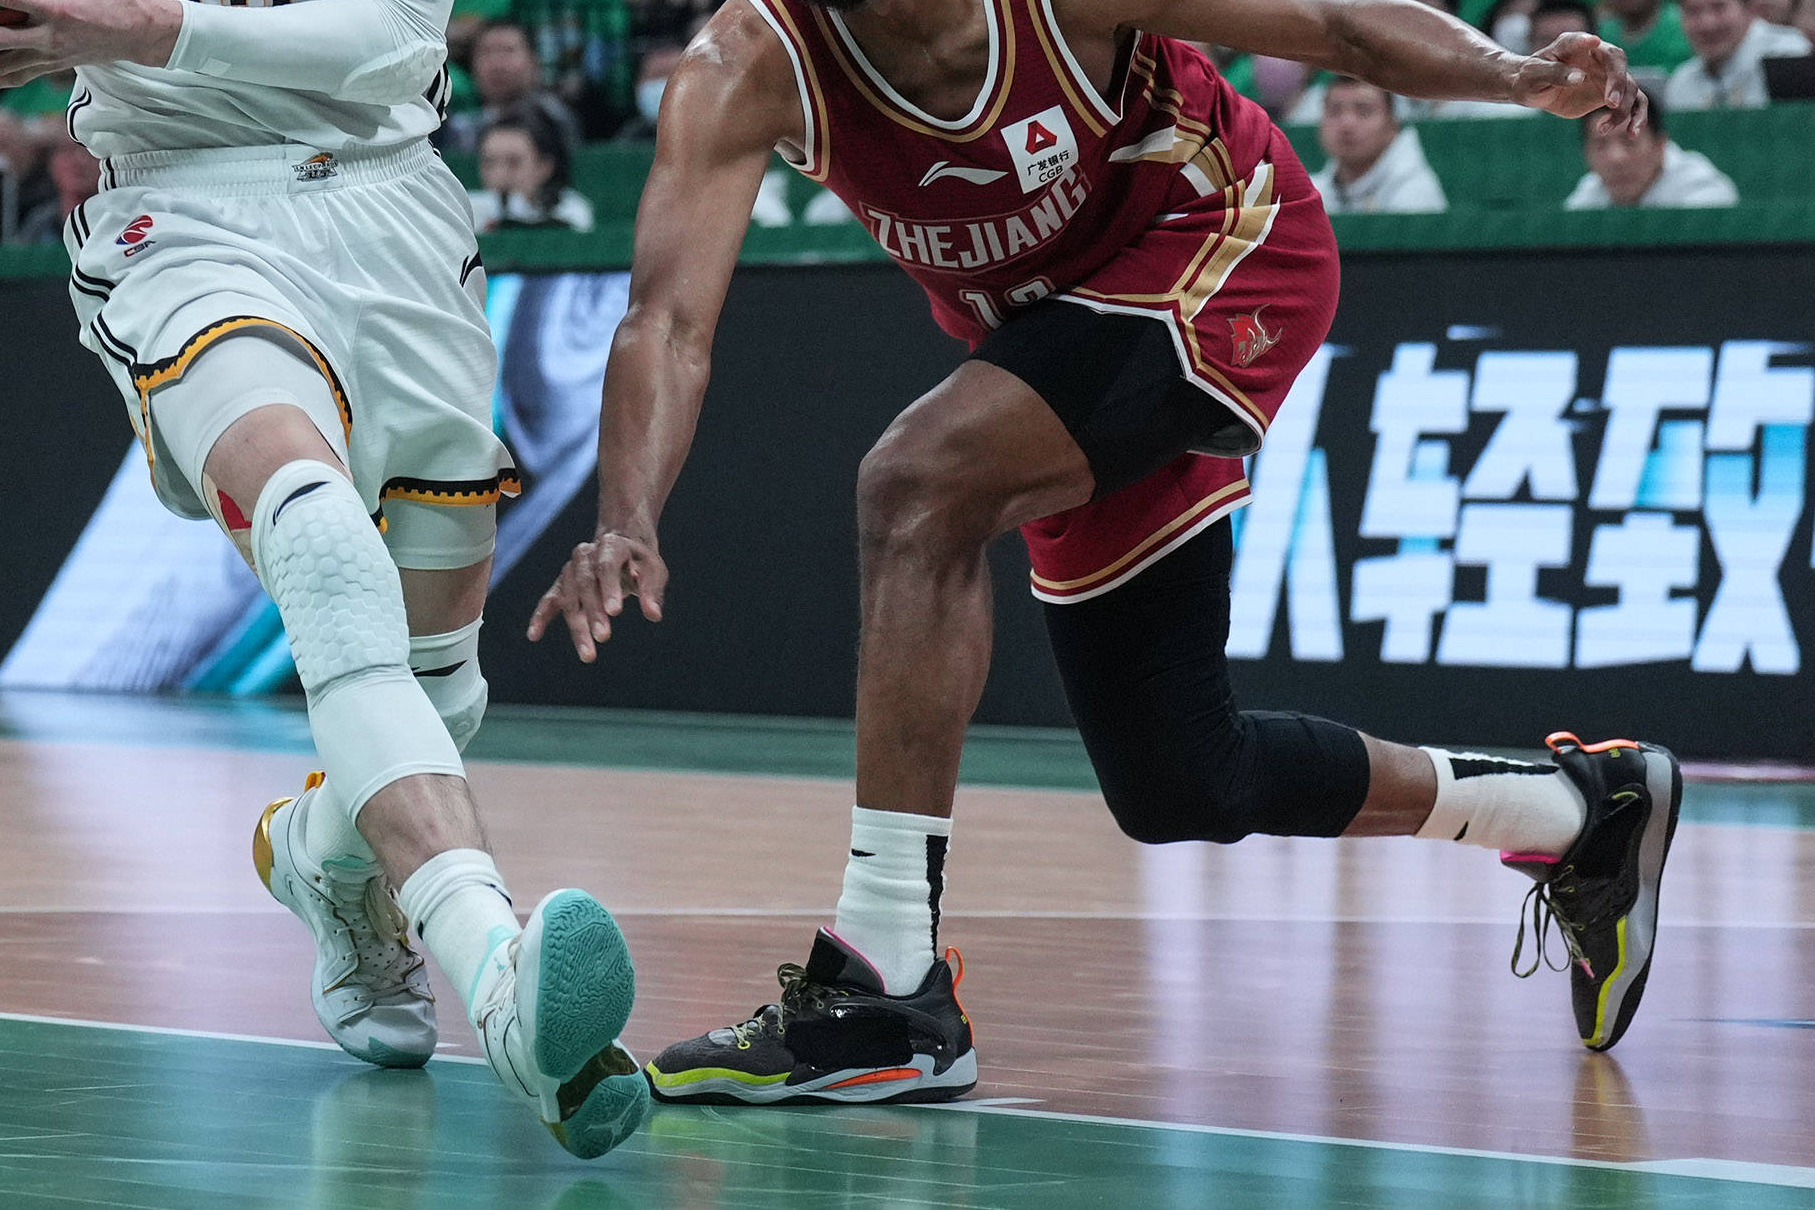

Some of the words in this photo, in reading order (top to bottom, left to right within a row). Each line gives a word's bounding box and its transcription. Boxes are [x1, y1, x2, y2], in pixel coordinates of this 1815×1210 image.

[1027, 150, 1070, 177] 广发银行
[1038, 164, 1064, 183] CGB
[867, 163, 1088, 269] ZHEJIANG
